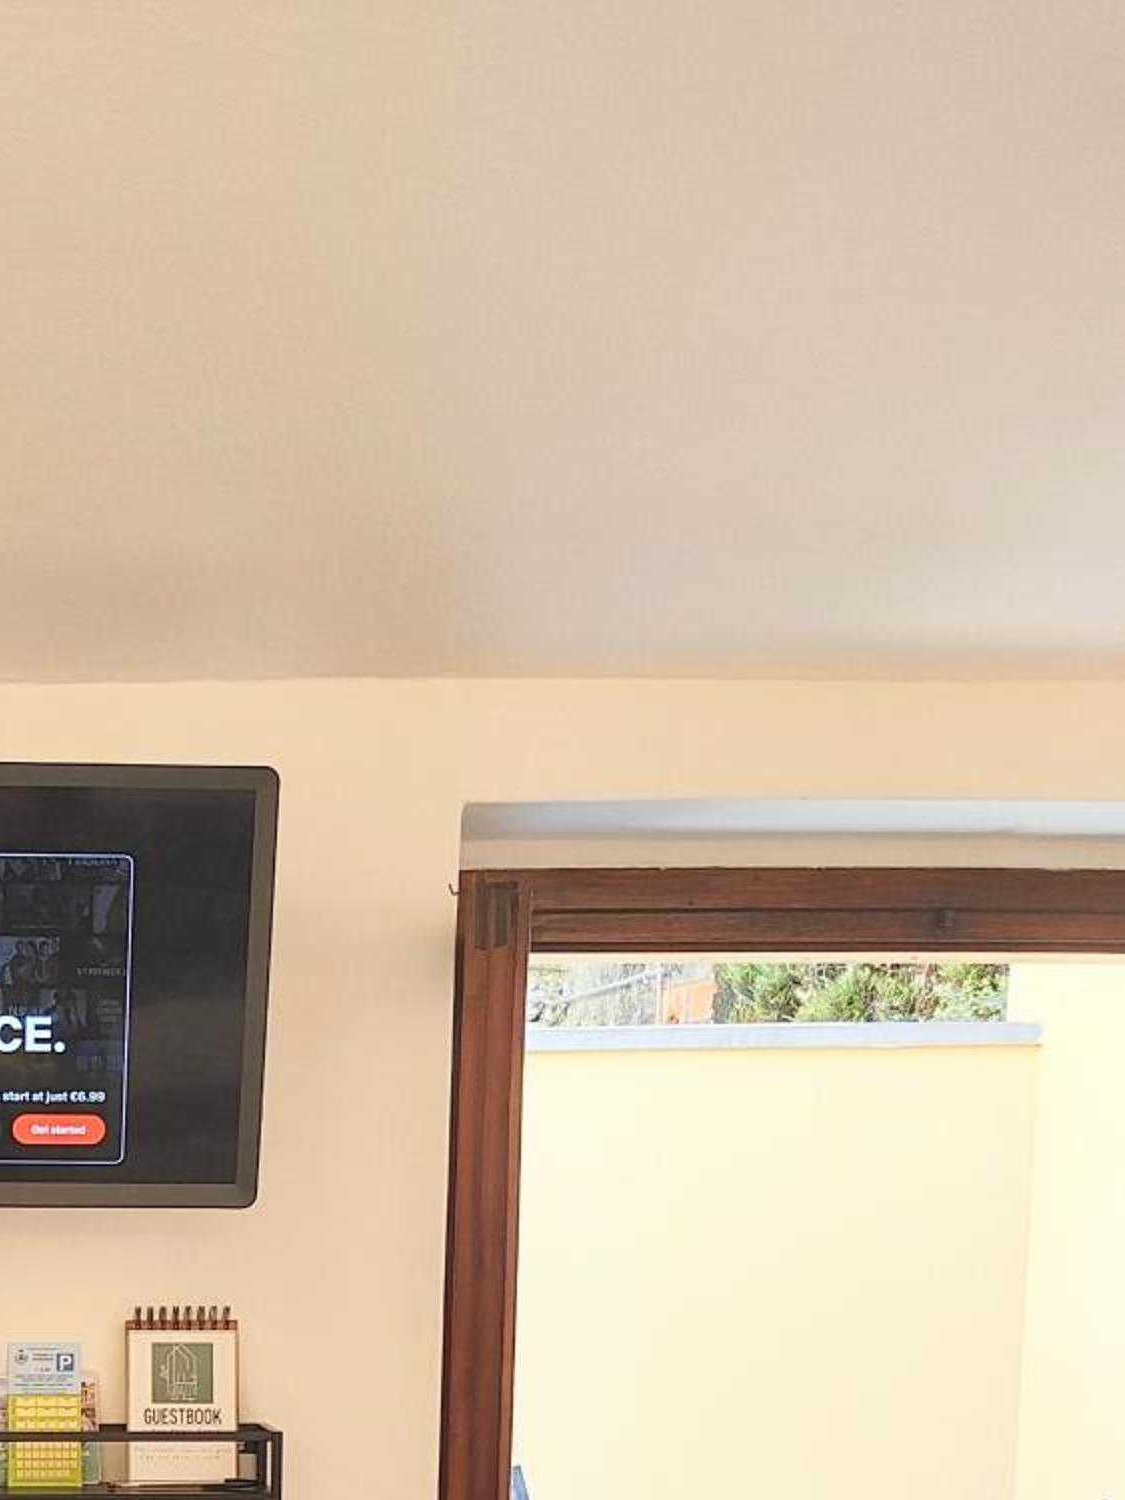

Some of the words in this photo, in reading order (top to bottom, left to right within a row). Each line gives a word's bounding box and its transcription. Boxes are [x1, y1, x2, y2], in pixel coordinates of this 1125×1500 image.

[3, 1091, 30, 1101] start
[32, 1091, 44, 1101] at
[45, 1090, 68, 1104] just
[70, 1091, 105, 1102] €6.99
[30, 1124, 49, 1135] Get
[51, 1124, 86, 1135] started
[59, 1355, 73, 1371] P
[144, 1407, 222, 1425] GUESTBOOK
